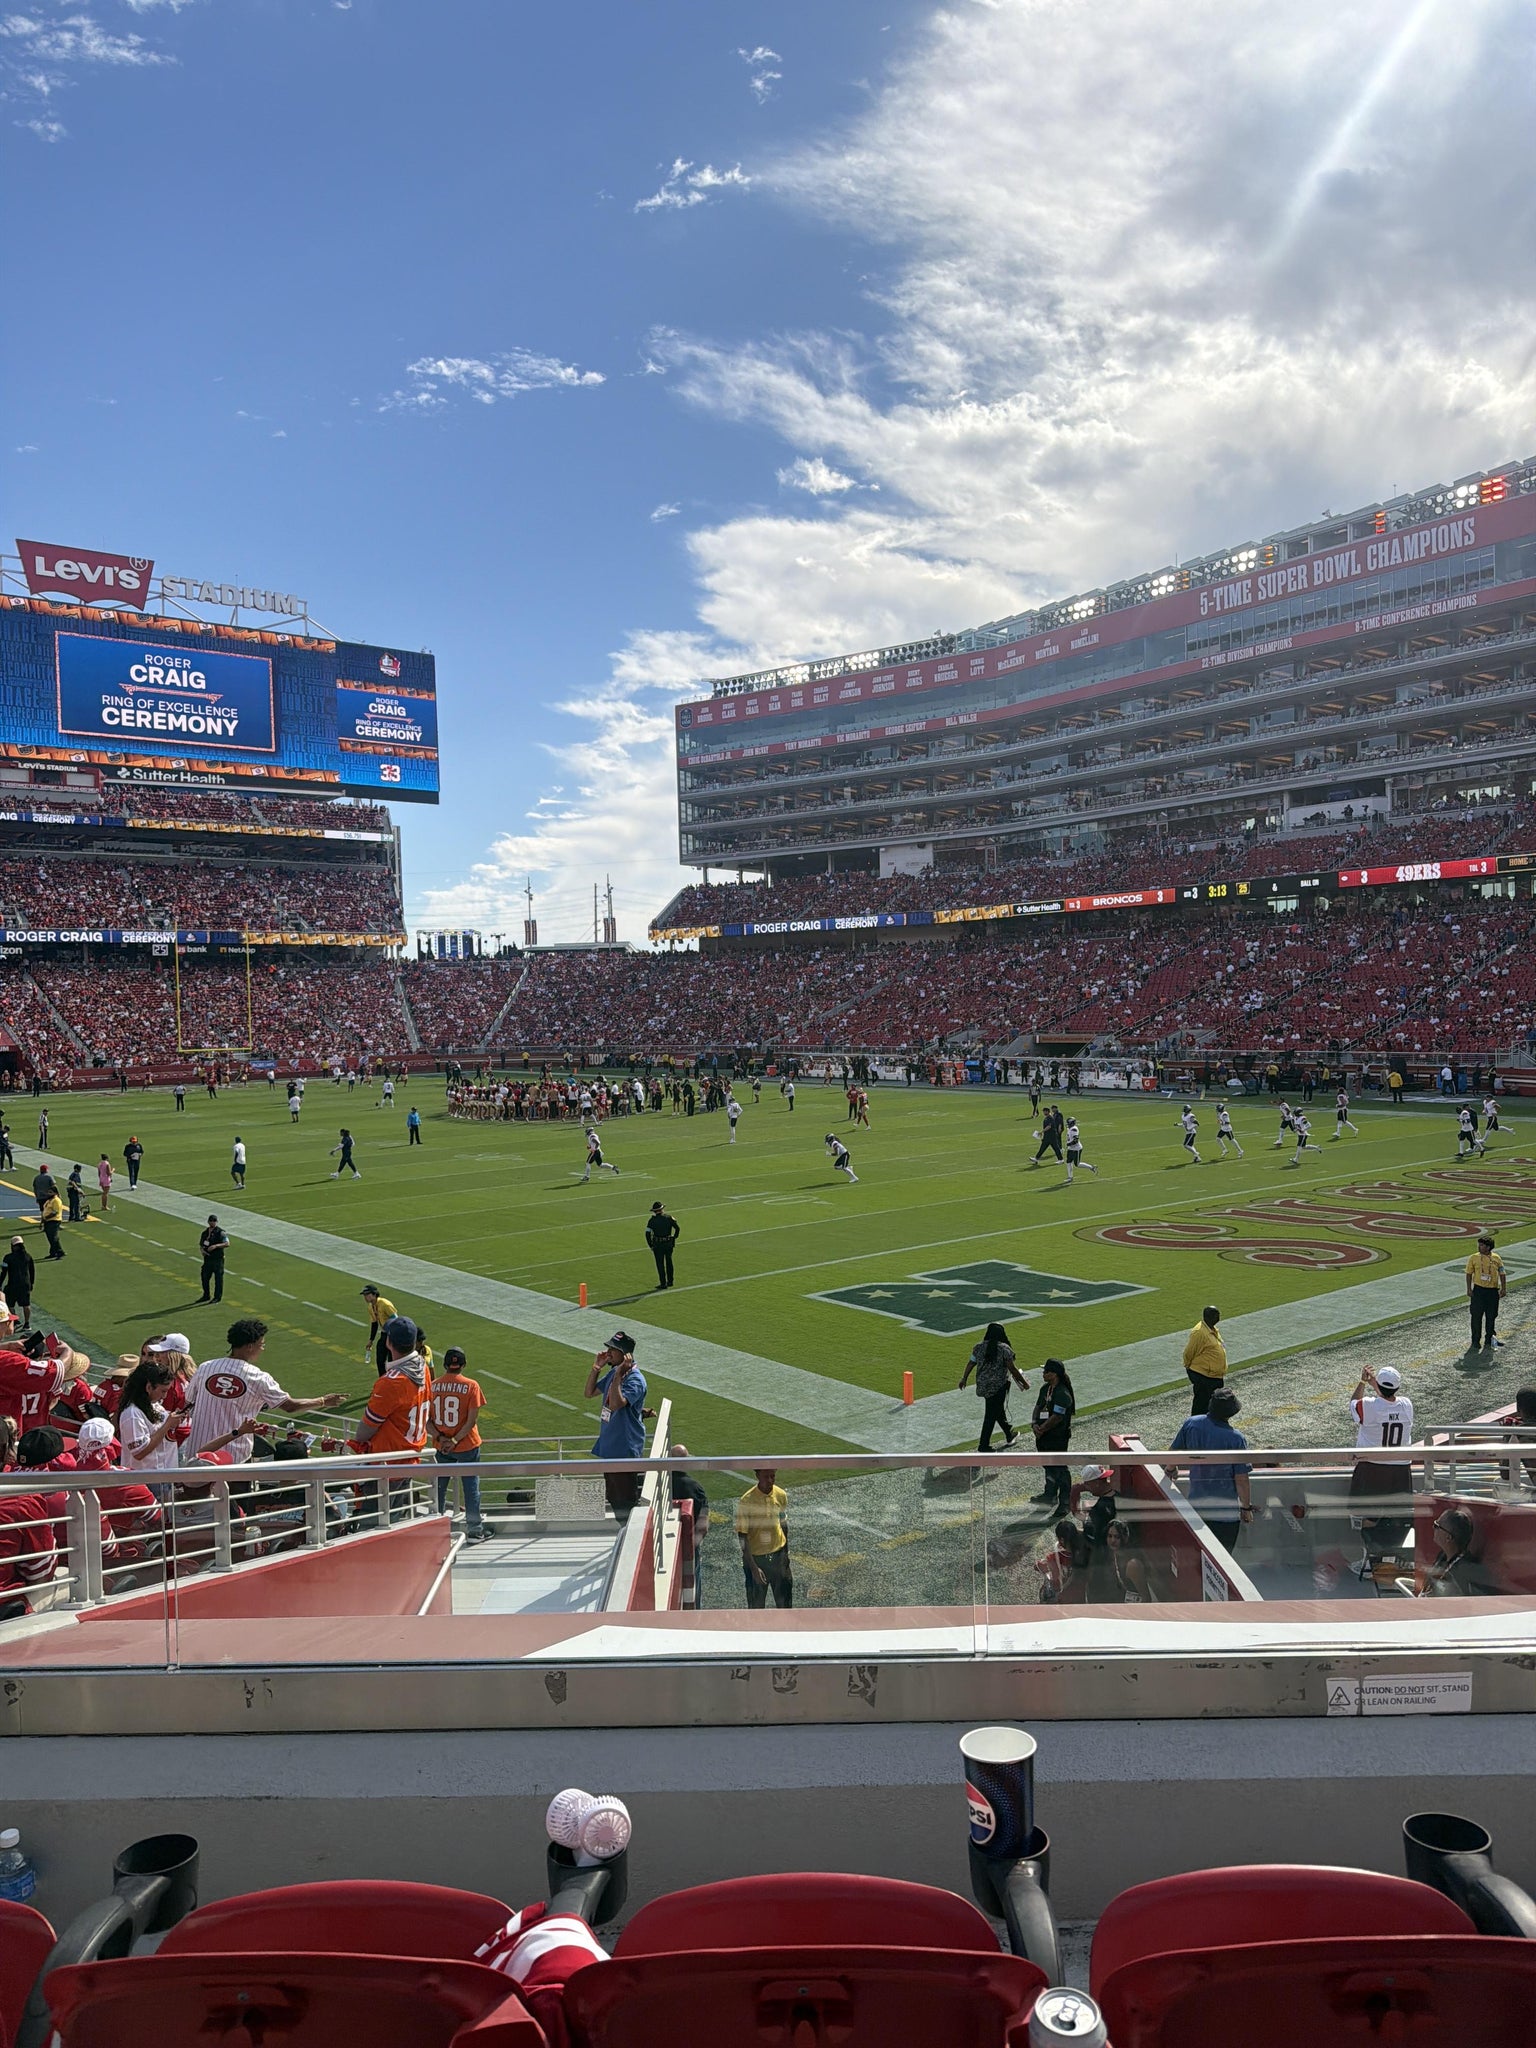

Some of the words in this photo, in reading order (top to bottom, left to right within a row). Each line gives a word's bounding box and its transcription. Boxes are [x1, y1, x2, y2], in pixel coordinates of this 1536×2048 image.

[1200, 579, 1252, 616] 5-TIME
[1257, 564, 1309, 601] SUPER
[1313, 550, 1361, 586] BOWL
[1366, 517, 1475, 571] CHAMPIONS
[162, 575, 299, 615] STADIUM
[1355, 616, 1381, 633] 8-TIME
[1381, 604, 1430, 626] CONFERENCE
[1432, 593, 1477, 615] CHAMPIONS
[1035, 645, 1060, 660] MONTANA
[1227, 646, 1254, 662] DIVISION
[1255, 637, 1293, 656] CHAMPIONS
[145, 654, 191, 669] ROGER
[130, 664, 206, 689] CRAIG
[970, 665, 985, 676] LOTT
[872, 681, 895, 693] JOHNSON
[905, 677, 923, 687] JONES
[813, 693, 829, 704] HALEY
[839, 688, 861, 699] JOHNSON
[101, 694, 134, 707] RING
[137, 698, 155, 709] OF
[158, 700, 238, 718] EXCELLENCE
[375, 697, 399, 706] ROGER
[768, 702, 780, 711] DEAN
[368, 703, 406, 717] CRAIG
[722, 709, 736, 719] CLARK
[101, 707, 239, 736] CEREMONY
[355, 718, 371, 726] RING
[382, 722, 422, 732] EXCELLENCE
[945, 715, 957, 727] BILL
[958, 713, 977, 724] WALSH
[355, 725, 422, 741] CEREMONY
[836, 735, 845, 743] VIC
[46, 764, 78, 772] STADIUM
[132, 768, 179, 782] Sutter
[180, 771, 226, 785] Health
[32, 816, 76, 824] CEREMONY
[1509, 857, 1529, 866] HOME
[1360, 870, 1368, 884] 3
[1395, 862, 1442, 882] 49ERS
[1469, 864, 1479, 872] TOL
[1481, 861, 1487, 873] 3
[1192, 887, 1198, 899] 3
[1208, 884, 1227, 898] 3:13
[1238, 883, 1248, 894] 25
[1076, 900, 1081, 910] 3
[1093, 893, 1143, 906] BRONCOS
[1157, 891, 1164, 902] 3
[1022, 905, 1041, 913] Sutter
[1041, 903, 1061, 912] Health
[753, 922, 787, 934] ROGER
[790, 920, 821, 931] CRAIG
[835, 921, 878, 930] CEREMONY
[6, 931, 56, 942] ROGER
[60, 931, 103, 942] CRAIG
[122, 935, 176, 943] CEREMONY
[154, 946, 166, 954] 25
[433, 1396, 460, 1427] 18
[1388, 1412, 1400, 1421] NIX
[404, 1400, 431, 1444] 10
[1382, 1422, 1404, 1447] 10
[1354, 1687, 1393, 1695] CAUTION:
[1394, 1686, 1407, 1694] DO
[1408, 1685, 1425, 1693] NOT
[1442, 1684, 1470, 1693] STAND
[1367, 1698, 1389, 1706] LEAN
[1390, 1697, 1402, 1705] ON
[1404, 1696, 1436, 1705] RAILING
